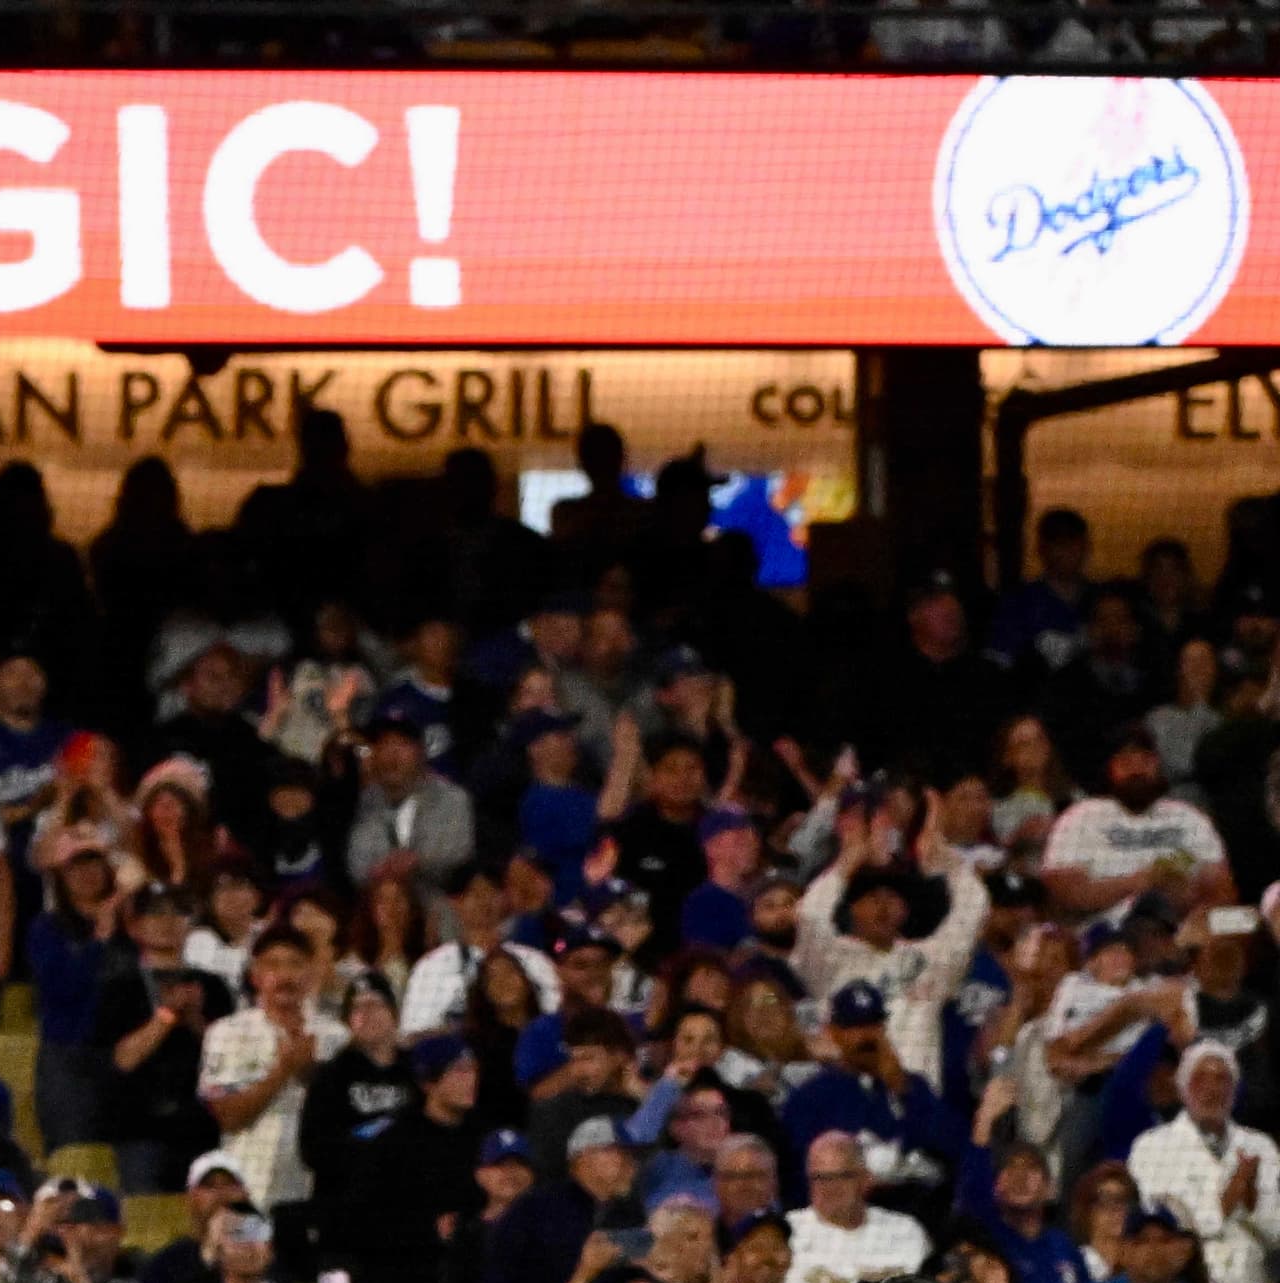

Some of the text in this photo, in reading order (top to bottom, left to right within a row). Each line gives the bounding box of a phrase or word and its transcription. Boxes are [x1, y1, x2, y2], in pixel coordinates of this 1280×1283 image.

[987, 145, 1200, 262] Dodgers
[118, 367, 335, 442] PARK
[374, 367, 592, 441] GRILL
